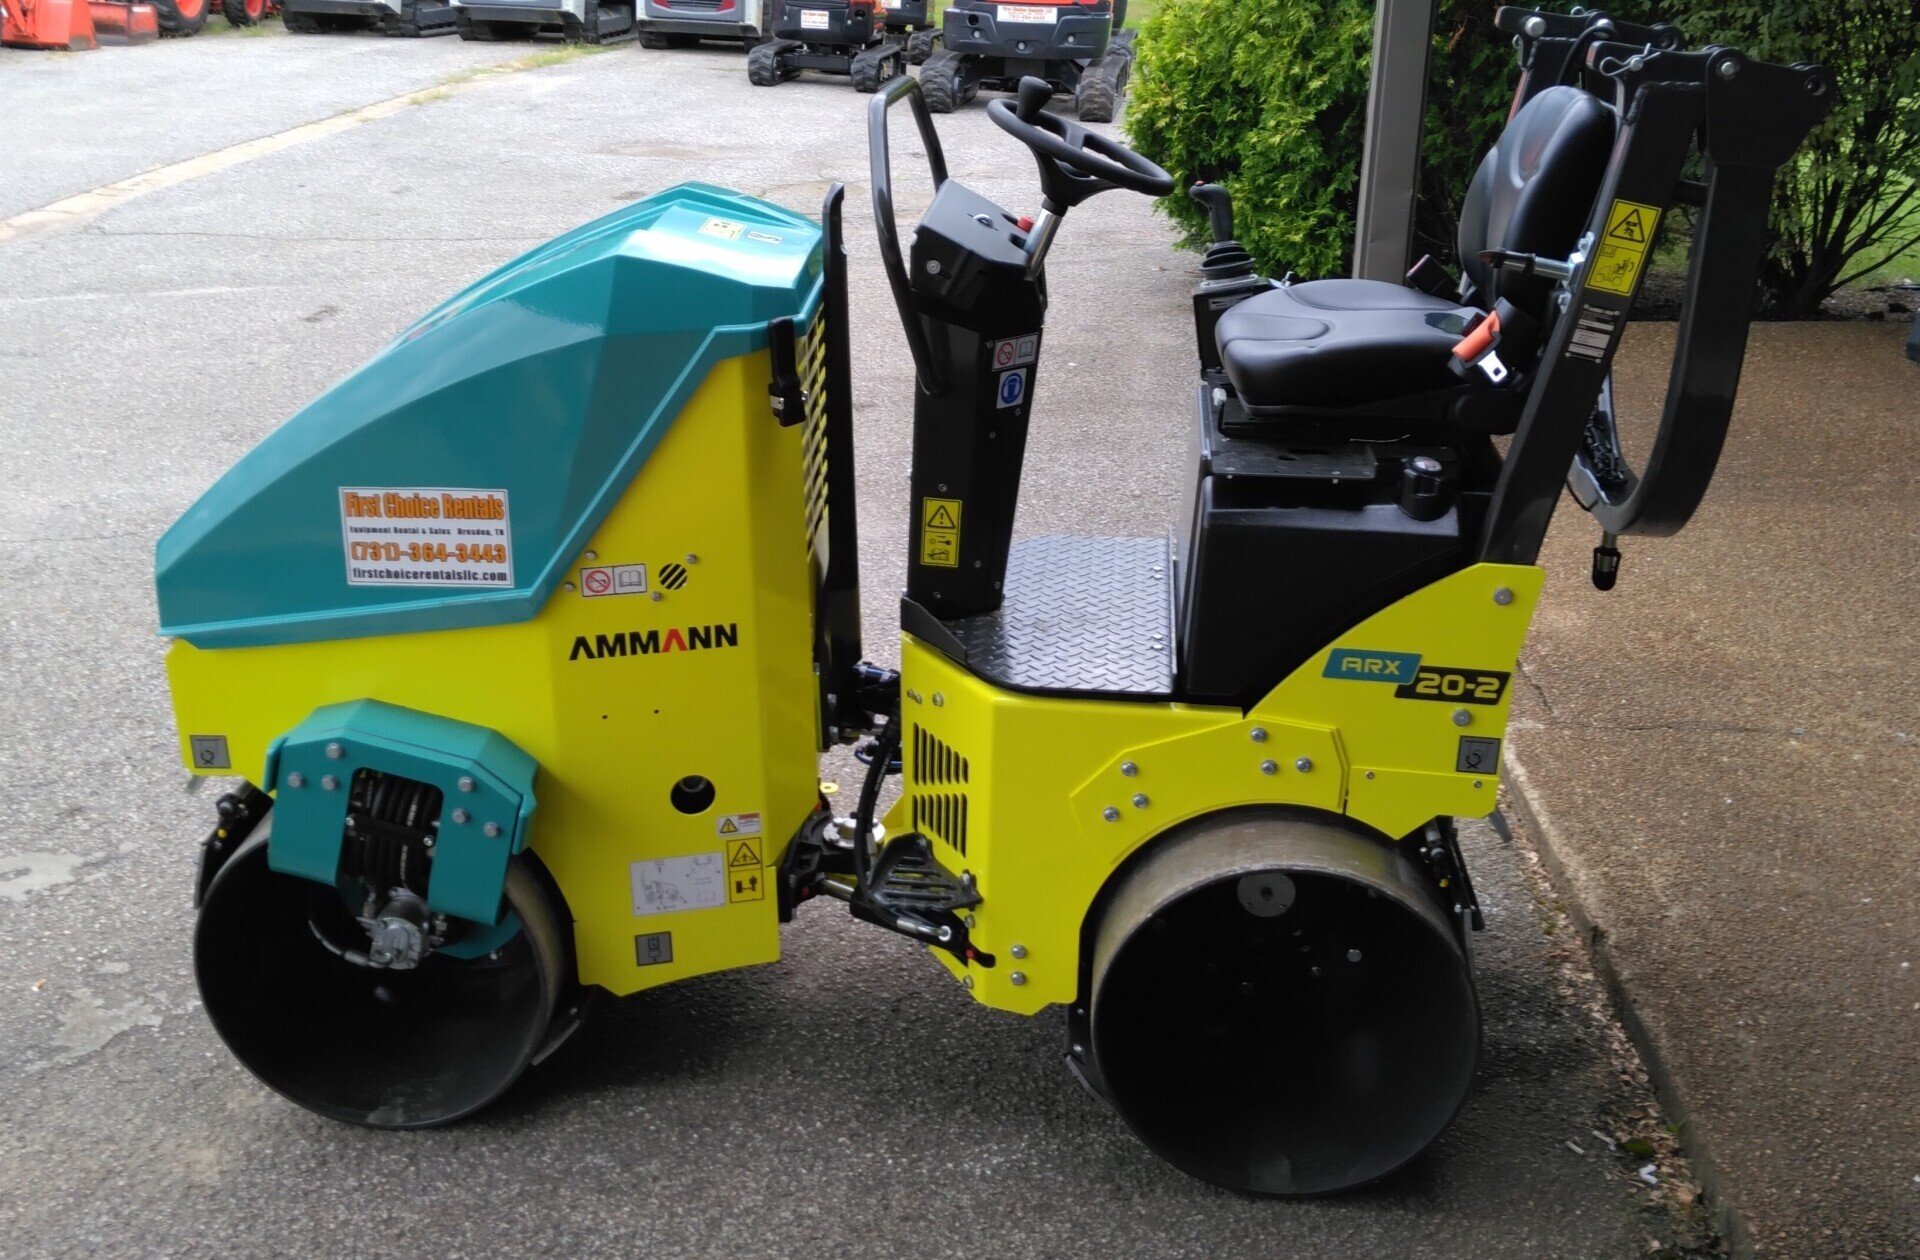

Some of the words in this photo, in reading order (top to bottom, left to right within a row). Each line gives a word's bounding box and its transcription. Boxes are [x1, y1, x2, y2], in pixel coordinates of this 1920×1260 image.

[345, 492, 381, 518] First
[382, 492, 440, 519] Choice
[441, 493, 505, 520] Rentals
[349, 526, 391, 535] Equipment
[393, 526, 419, 535] Rental
[494, 528, 504, 536] TN
[351, 541, 507, 564] (731)-364-3443
[353, 567, 508, 582] firstchoicerentalsllc.com
[569, 623, 738, 661] AMMANN
[1342, 657, 1402, 675] ARX
[1415, 672, 1501, 699] 20-2
